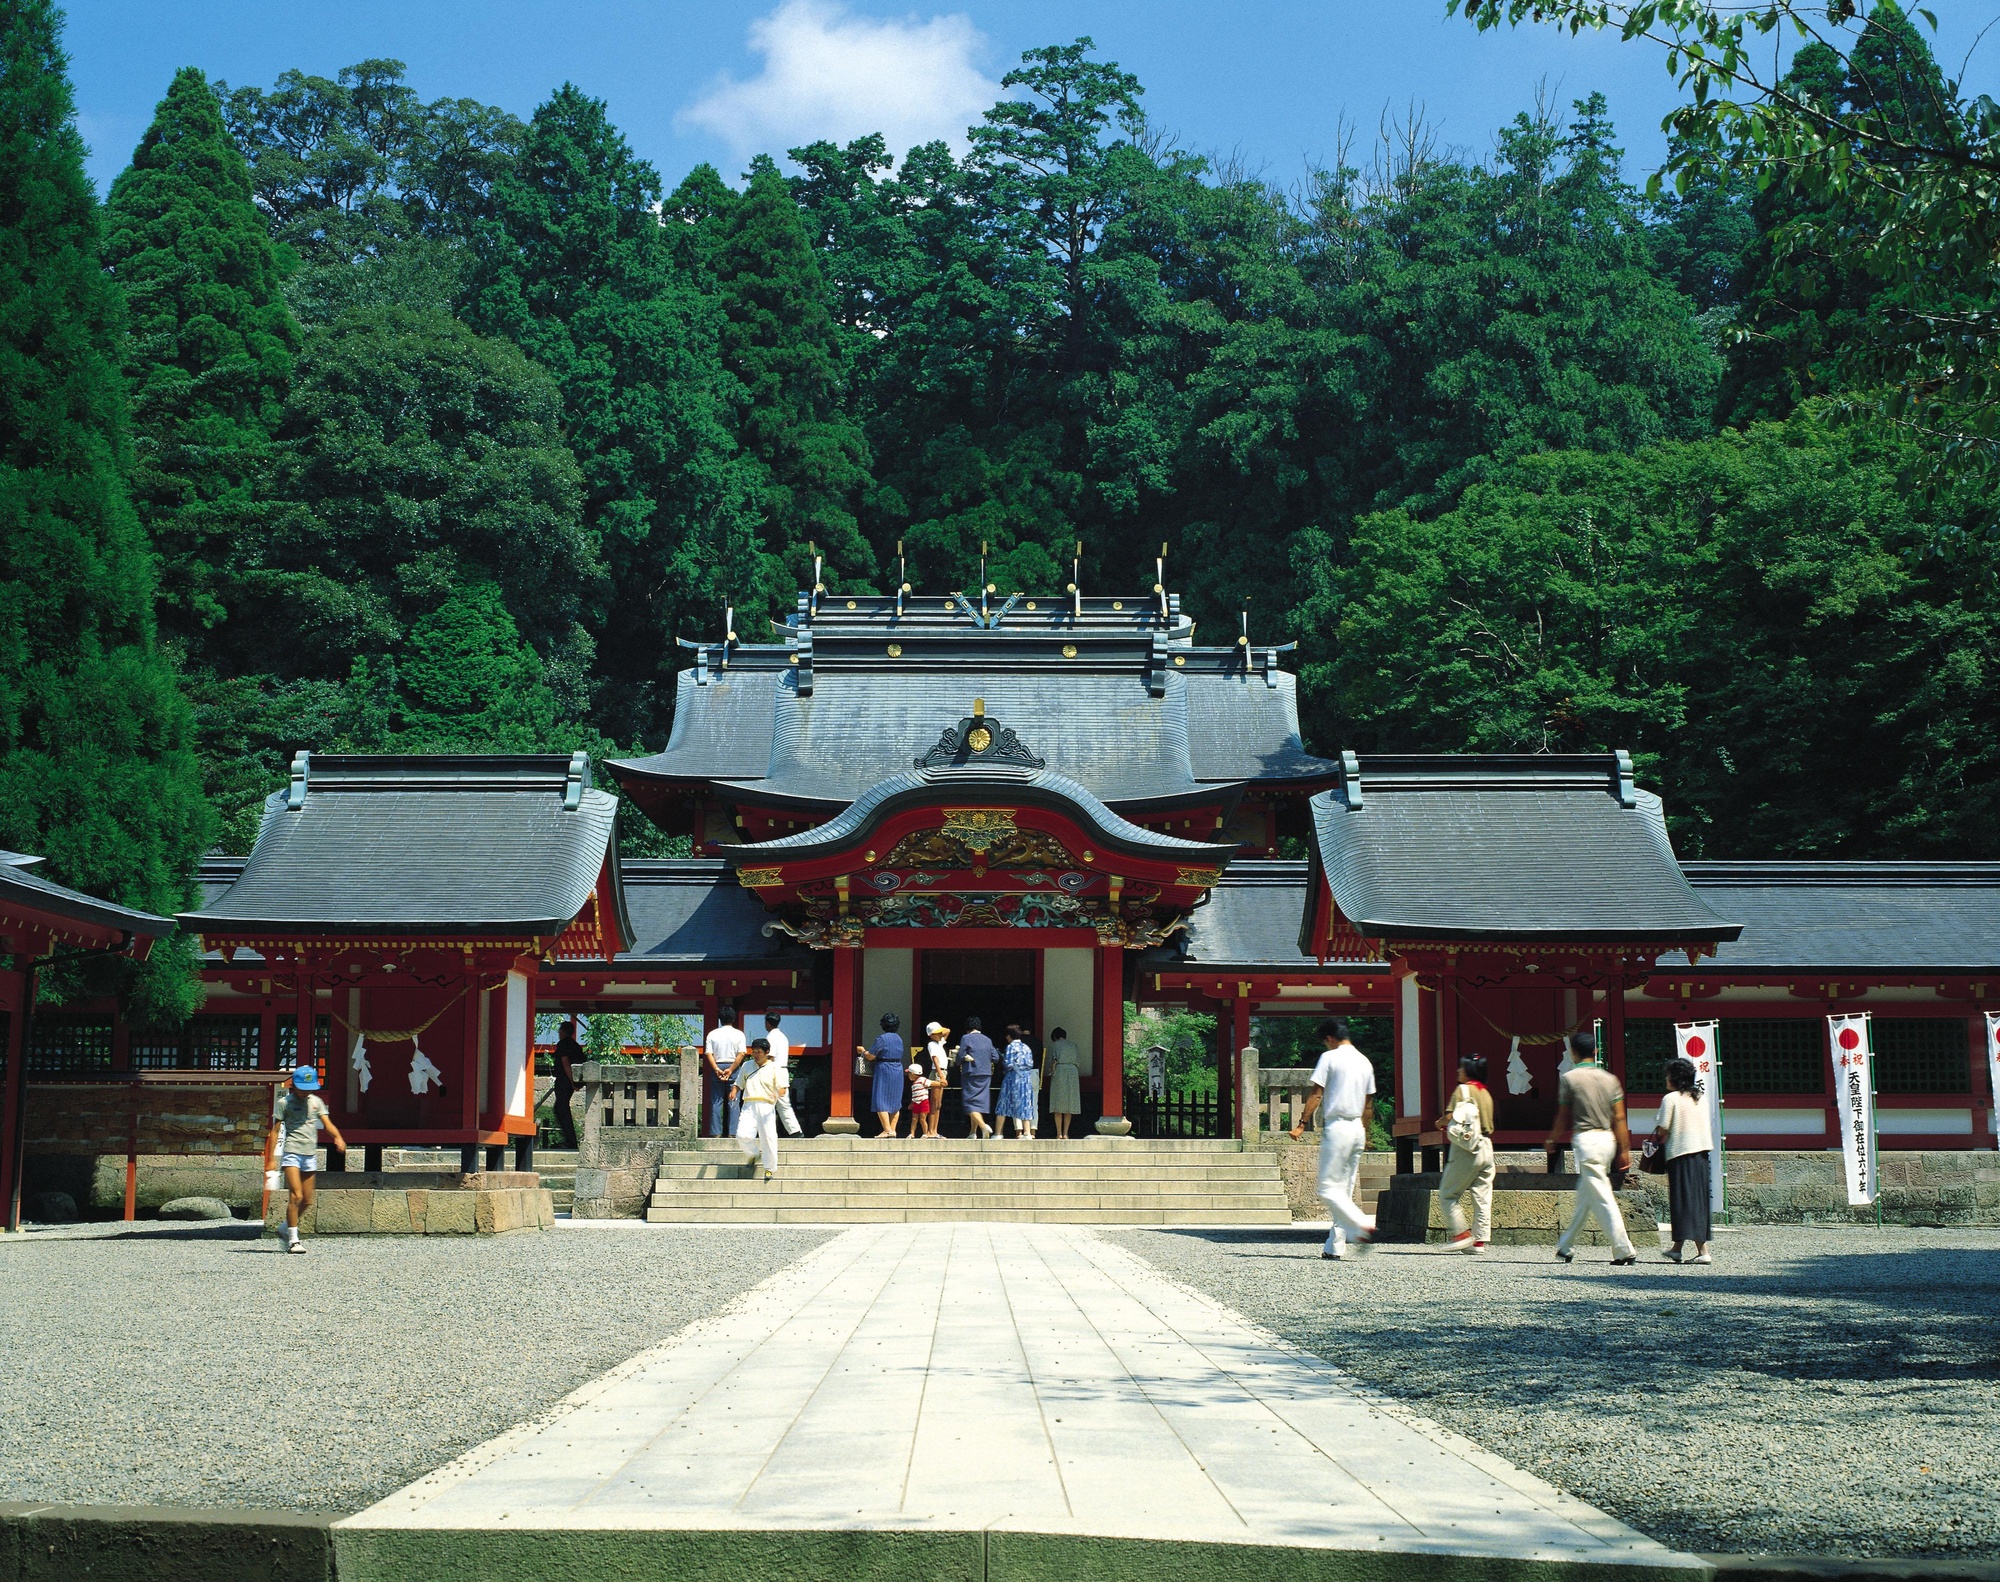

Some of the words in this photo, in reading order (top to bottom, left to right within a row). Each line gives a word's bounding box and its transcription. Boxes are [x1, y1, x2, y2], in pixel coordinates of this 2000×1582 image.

[1699, 1060, 1711, 1073] 祝
[1839, 1053, 1864, 1068] 奉祝
[1848, 1071, 1867, 1195] 天皇陛下御在位六十年
